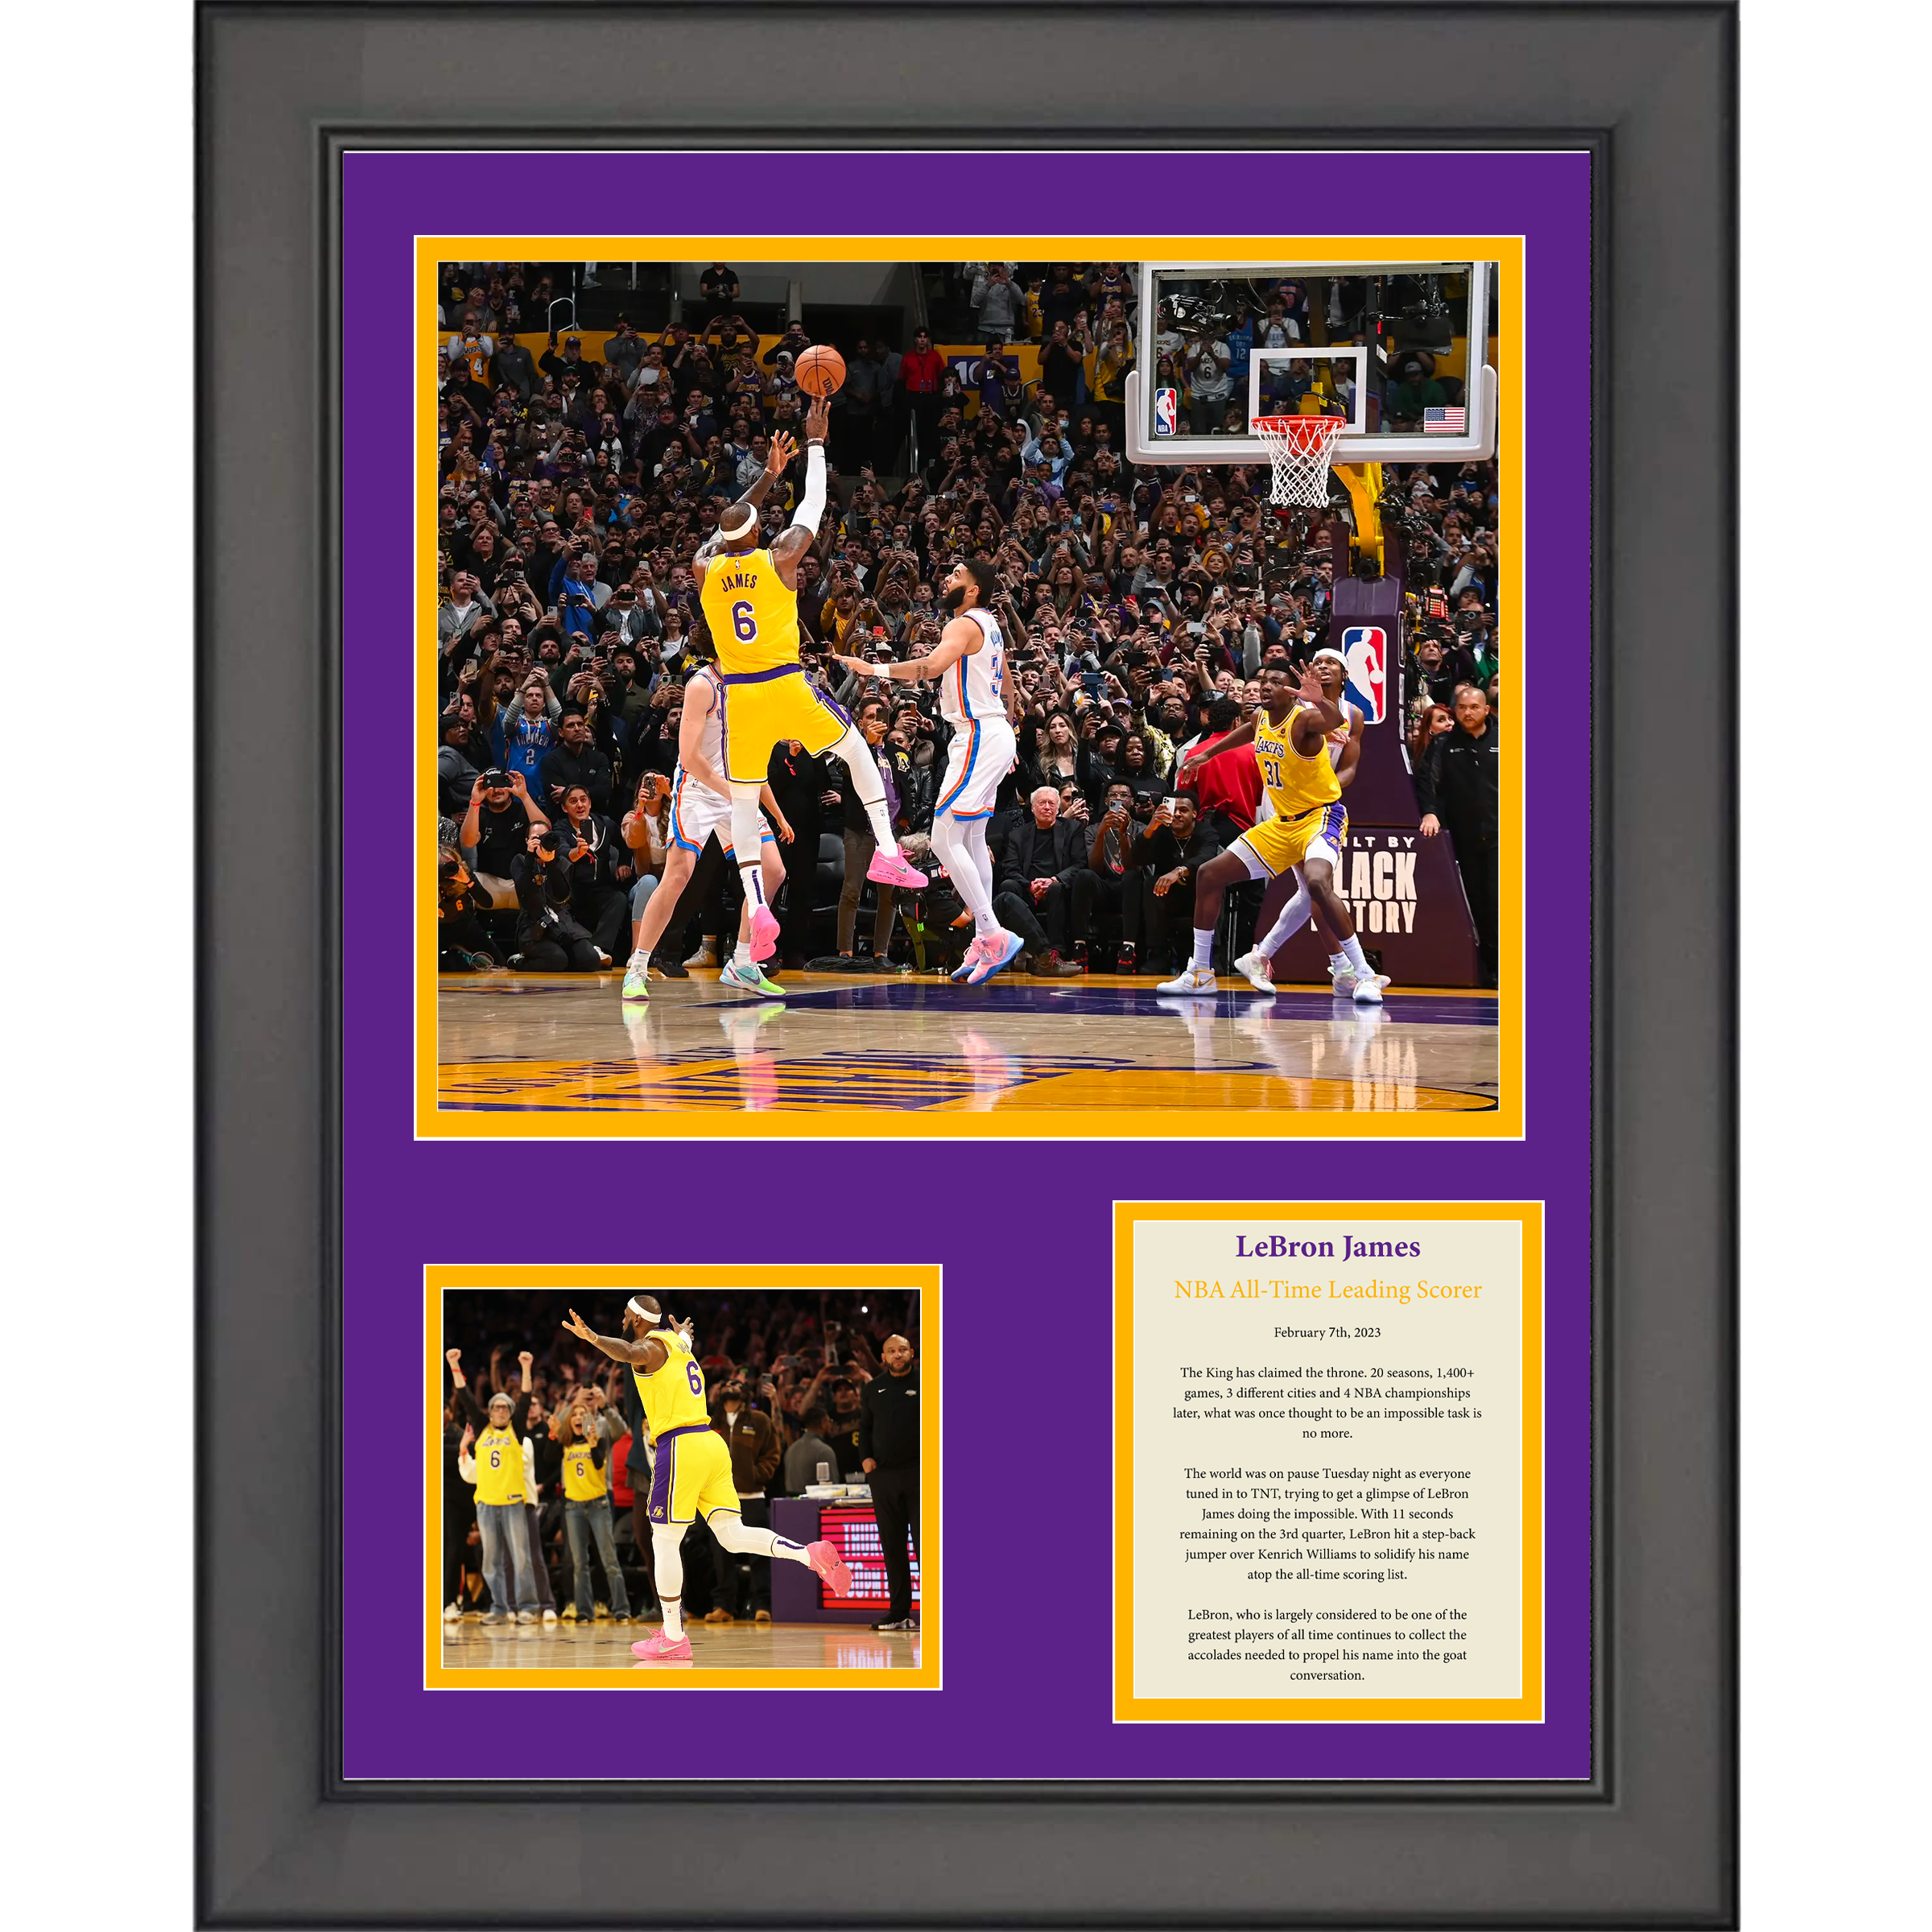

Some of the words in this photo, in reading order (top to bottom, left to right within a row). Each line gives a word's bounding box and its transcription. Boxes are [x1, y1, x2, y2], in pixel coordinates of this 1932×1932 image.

[1236, 348, 1246, 360] 12
[1203, 365, 1212, 379] 6
[1158, 423, 1168, 432] NBA
[721, 573, 758, 592] JAMES
[731, 600, 758, 644] 6
[1256, 736, 1286, 758] LAKERS
[526, 748, 535, 766] 2
[1264, 759, 1284, 789] 31
[1343, 836, 1372, 848] ILT
[1388, 836, 1414, 848] BY
[1332, 851, 1417, 900] LACK
[456, 899, 463, 911] 6
[1311, 900, 1417, 933] TORY
[1236, 1236, 1335, 1257] LeBron
[1343, 1236, 1420, 1261] James
[1174, 1281, 1225, 1298] NBA
[1230, 1279, 1321, 1298] All-Time
[1328, 1279, 1410, 1304] Leading
[1418, 1281, 1482, 1298] Scorer
[1274, 1327, 1326, 1341] February
[1329, 1327, 1350, 1339] 7th,
[1353, 1327, 1381, 1339] 2023
[685, 1360, 703, 1398] 6
[1179, 1366, 1203, 1378] The
[1206, 1368, 1233, 1381] King
[1236, 1366, 1256, 1378] has
[1257, 1366, 1302, 1378] claimed
[1305, 1366, 1324, 1378] the
[1326, 1366, 1368, 1378] throne.
[1369, 1367, 1384, 1378] 20
[1386, 1369, 1433, 1380] seasons,
[1437, 1368, 1474, 1379] 1,400+
[1184, 1390, 1223, 1402] games,
[1226, 1387, 1233, 1399] 3
[1236, 1387, 1284, 1398] different
[1286, 1387, 1317, 1399] cities
[1319, 1387, 1340, 1398] and
[1344, 1387, 1352, 1398] 4
[1353, 1387, 1383, 1399] NBA
[1385, 1387, 1470, 1402] championships
[1173, 1407, 1200, 1419] later,
[1203, 1406, 1232, 1418] what
[1233, 1410, 1256, 1418] was
[1258, 1410, 1286, 1418] once
[1289, 1407, 1332, 1422] thought
[1335, 1409, 1348, 1418] to
[1349, 1406, 1364, 1418] be
[1366, 1410, 1381, 1418] an
[1384, 1407, 1444, 1421] impossible
[1447, 1406, 1471, 1418] task
[1472, 1407, 1483, 1418] is
[1302, 1430, 1318, 1439] no
[1319, 1430, 1353, 1439] more.
[490, 1449, 501, 1469] 6
[576, 1462, 584, 1476] 6
[1183, 1467, 1207, 1479] The
[1209, 1468, 1242, 1479] world
[1245, 1470, 1267, 1480] was
[1269, 1470, 1285, 1480] on
[1286, 1470, 1320, 1482] pause
[1323, 1468, 1369, 1482] Tuesday
[1373, 1468, 1402, 1482] night
[1404, 1470, 1417, 1480] as
[1419, 1471, 1471, 1482] everyone
[1185, 1487, 1220, 1499] tuned
[1221, 1488, 1233, 1499] in
[1236, 1488, 1249, 1500] to
[1251, 1488, 1281, 1500] TNT,
[1285, 1488, 1319, 1502] trying
[1322, 1489, 1334, 1500] to
[1337, 1490, 1353, 1502] get
[1356, 1491, 1364, 1499] a
[1366, 1488, 1410, 1502] glimpse
[1413, 1488, 1426, 1499] of
[1426, 1488, 1469, 1500] LeBron
[1202, 1509, 1234, 1521] James
[1237, 1508, 1269, 1522] doing
[1274, 1508, 1290, 1519] the
[1294, 1508, 1357, 1522] impossible.
[1360, 1508, 1389, 1519] With
[1393, 1509, 1406, 1520] 11
[1409, 1508, 1453, 1519] seconds
[1180, 1529, 1237, 1542] remaining
[1240, 1531, 1256, 1540] on
[1258, 1528, 1276, 1539] the
[1280, 1528, 1298, 1539] 3rd
[1302, 1530, 1345, 1542] quarter,
[1348, 1528, 1391, 1540] LeBron
[1393, 1527, 1410, 1539] hit
[1412, 1531, 1420, 1539] a
[1422, 1528, 1476, 1542] step-back
[1185, 1550, 1227, 1563] jumper
[1229, 1551, 1256, 1560] over
[1257, 1548, 1303, 1560] Kenrich
[1307, 1548, 1356, 1559] Williams
[1360, 1550, 1372, 1560] to
[1374, 1548, 1415, 1563] solidify
[1418, 1548, 1435, 1560] his
[1438, 1551, 1470, 1560] name
[1248, 1571, 1272, 1583] atop
[1276, 1568, 1293, 1579] the
[1296, 1568, 1340, 1579] all-time
[1343, 1569, 1385, 1583] scoring
[1388, 1568, 1407, 1579] list.
[1188, 1609, 1232, 1621] LeBron,
[1236, 1608, 1261, 1620] who
[1263, 1608, 1273, 1620] is
[1276, 1609, 1313, 1623] largely
[1316, 1608, 1377, 1620] considered
[1380, 1610, 1392, 1620] to
[1394, 1608, 1409, 1620] be
[1410, 1612, 1433, 1620] one
[1435, 1608, 1447, 1620] of
[1449, 1608, 1468, 1620] the
[1188, 1631, 1231, 1643] greatest
[1235, 1629, 1274, 1643] players
[1278, 1629, 1290, 1640] of
[1291, 1629, 1305, 1640] all
[1307, 1629, 1334, 1641] time
[1336, 1629, 1392, 1641] continues
[1394, 1630, 1406, 1641] to
[1409, 1629, 1446, 1640] collect
[1449, 1629, 1467, 1640] the
[1188, 1649, 1241, 1660] accolades
[1245, 1649, 1286, 1660] needed
[1288, 1650, 1300, 1661] to
[1302, 1649, 1340, 1663] propel
[1342, 1649, 1360, 1661] his
[1361, 1652, 1394, 1661] name
[1396, 1649, 1420, 1661] into
[1422, 1649, 1441, 1661] the
[1443, 1651, 1467, 1663] goat
[1290, 1670, 1365, 1681] conversation.
